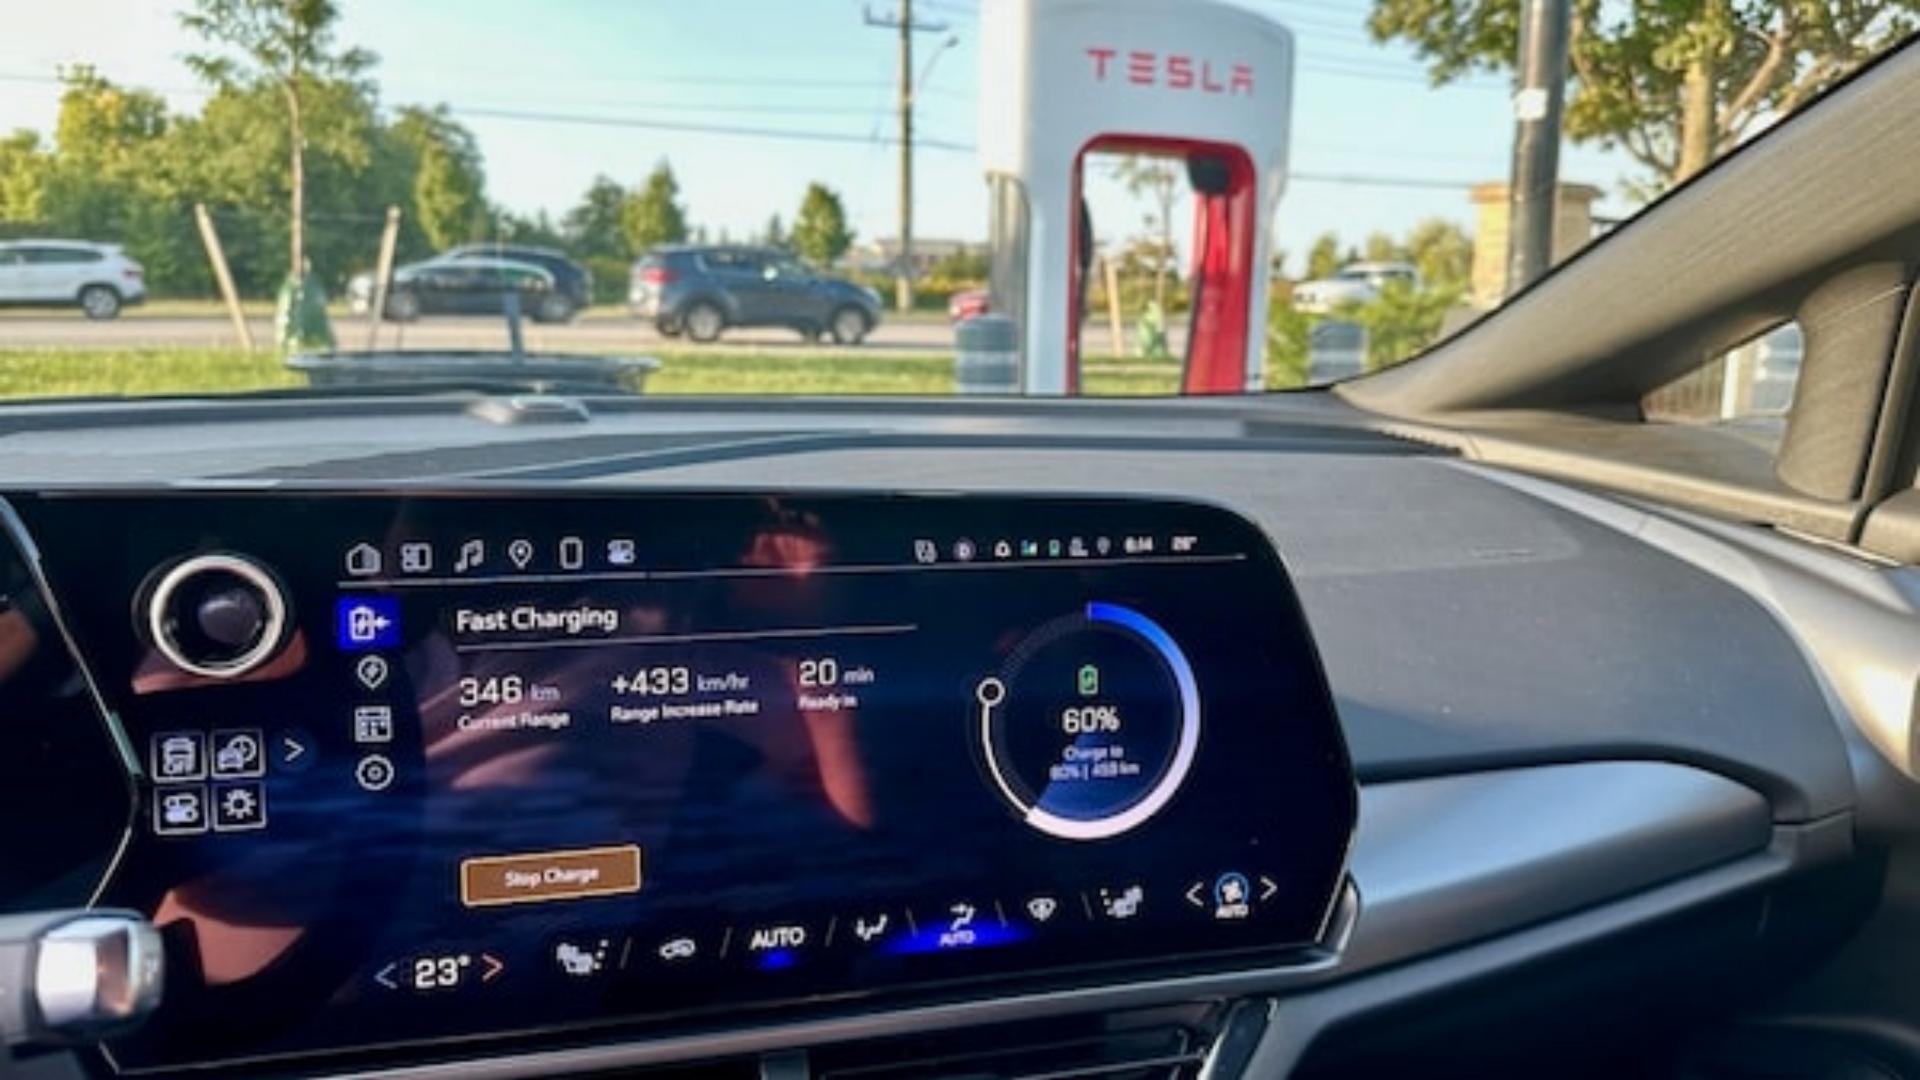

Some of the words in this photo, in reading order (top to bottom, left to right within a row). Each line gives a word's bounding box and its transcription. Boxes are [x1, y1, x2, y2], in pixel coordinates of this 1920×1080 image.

[1087, 48, 1254, 95] TESLA
[456, 609, 507, 632] Fast
[511, 606, 619, 634] Charging
[611, 667, 689, 696] +433
[697, 672, 750, 692] km/hr
[799, 658, 837, 686] 20
[843, 668, 875, 684] min
[459, 675, 523, 707] 346
[530, 682, 561, 700] km
[798, 695, 842, 711] Ready
[844, 693, 858, 708] in
[457, 714, 517, 730] Current
[520, 711, 571, 730] Range
[610, 705, 659, 723] Range
[662, 702, 722, 719] Increase
[724, 700, 759, 714] Rate
[1062, 706, 1121, 734] 60%
[504, 870, 542, 889] Stop
[543, 866, 600, 885] Charge
[1215, 904, 1249, 919] AUTO
[750, 926, 805, 949] AUTO
[939, 930, 976, 947] AUTO
[415, 954, 471, 988] 23°
